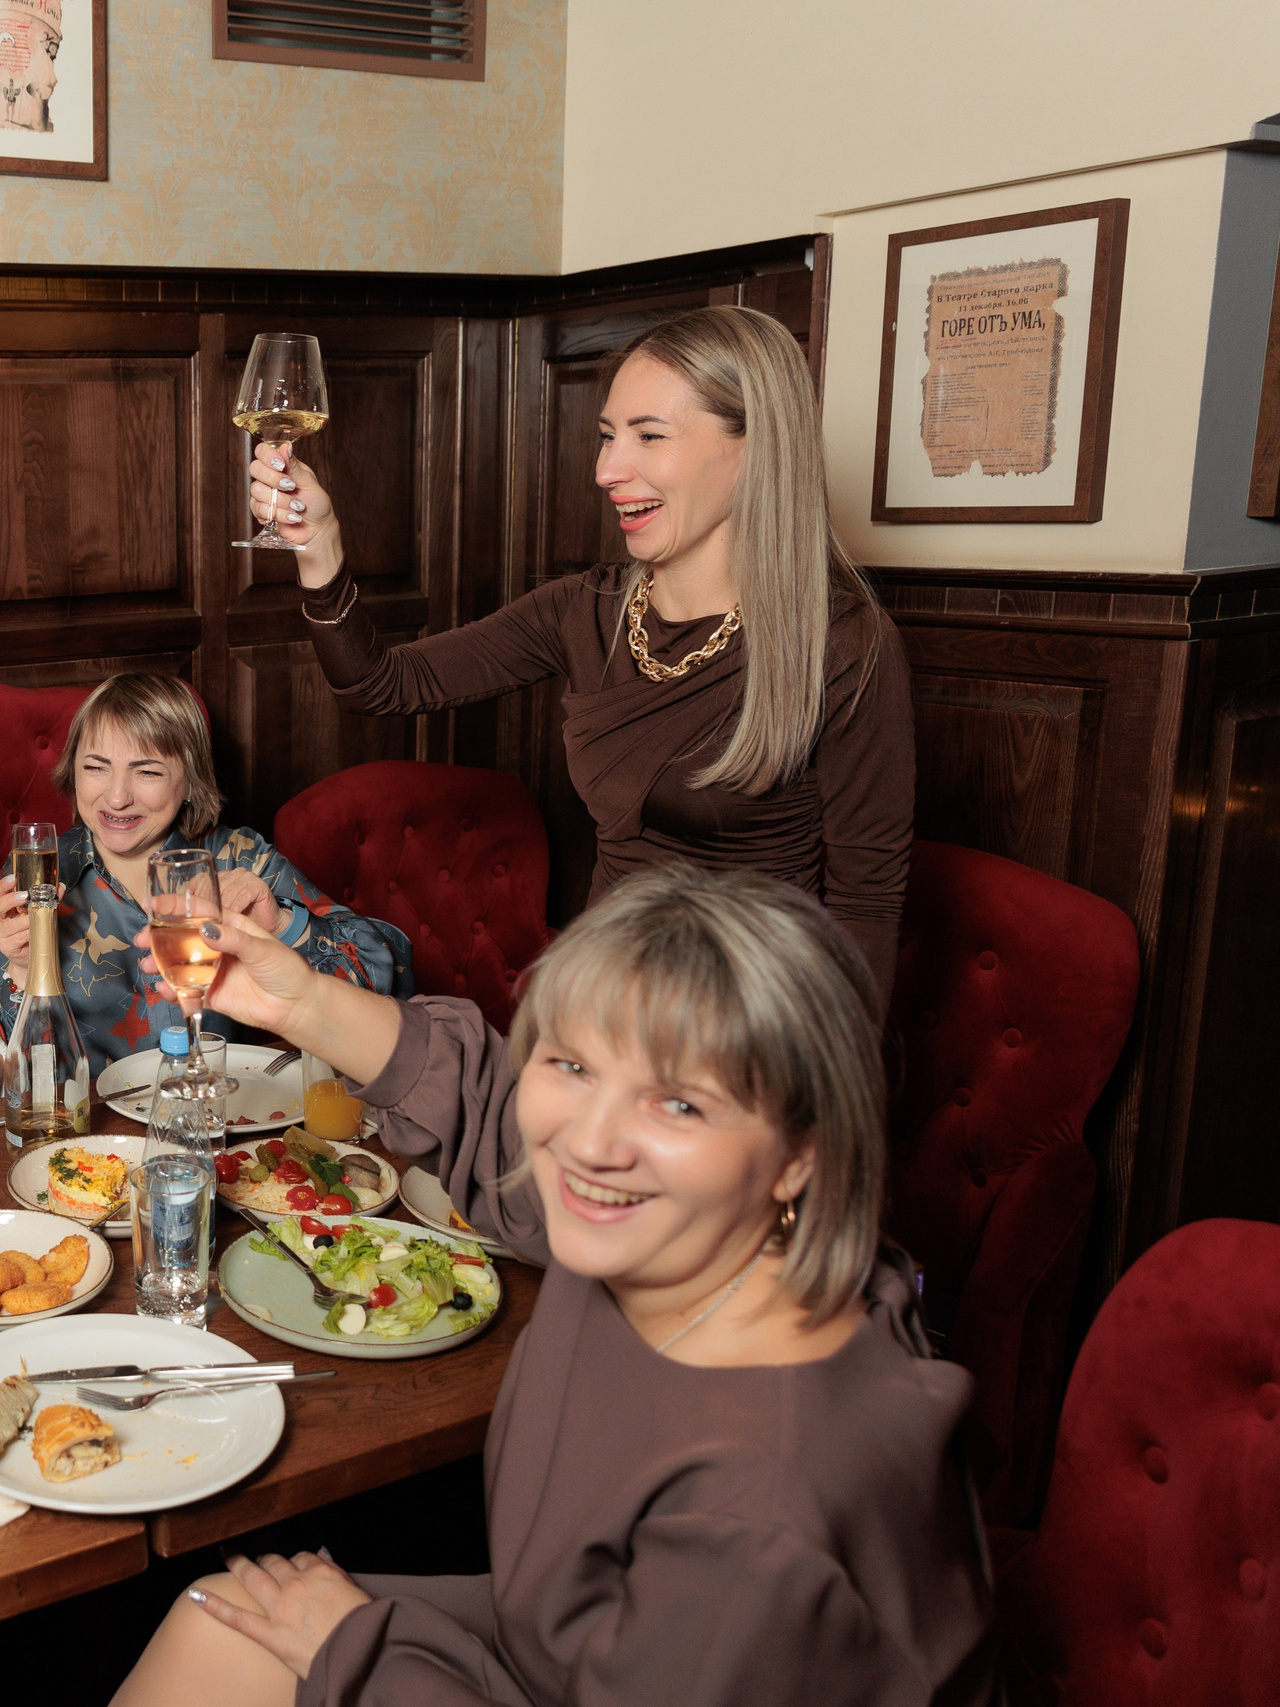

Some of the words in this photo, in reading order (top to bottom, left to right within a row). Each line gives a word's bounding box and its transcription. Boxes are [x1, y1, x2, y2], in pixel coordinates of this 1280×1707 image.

[936, 295, 944, 303] В
[946, 292, 978, 302] Театре
[980, 287, 1019, 298] Старого
[1023, 283, 1054, 293] парка
[958, 305, 967, 313] 11
[941, 317, 974, 338] ГОРЕ
[978, 314, 1007, 334] ОТЪ
[1011, 309, 1046, 331] УМА,
